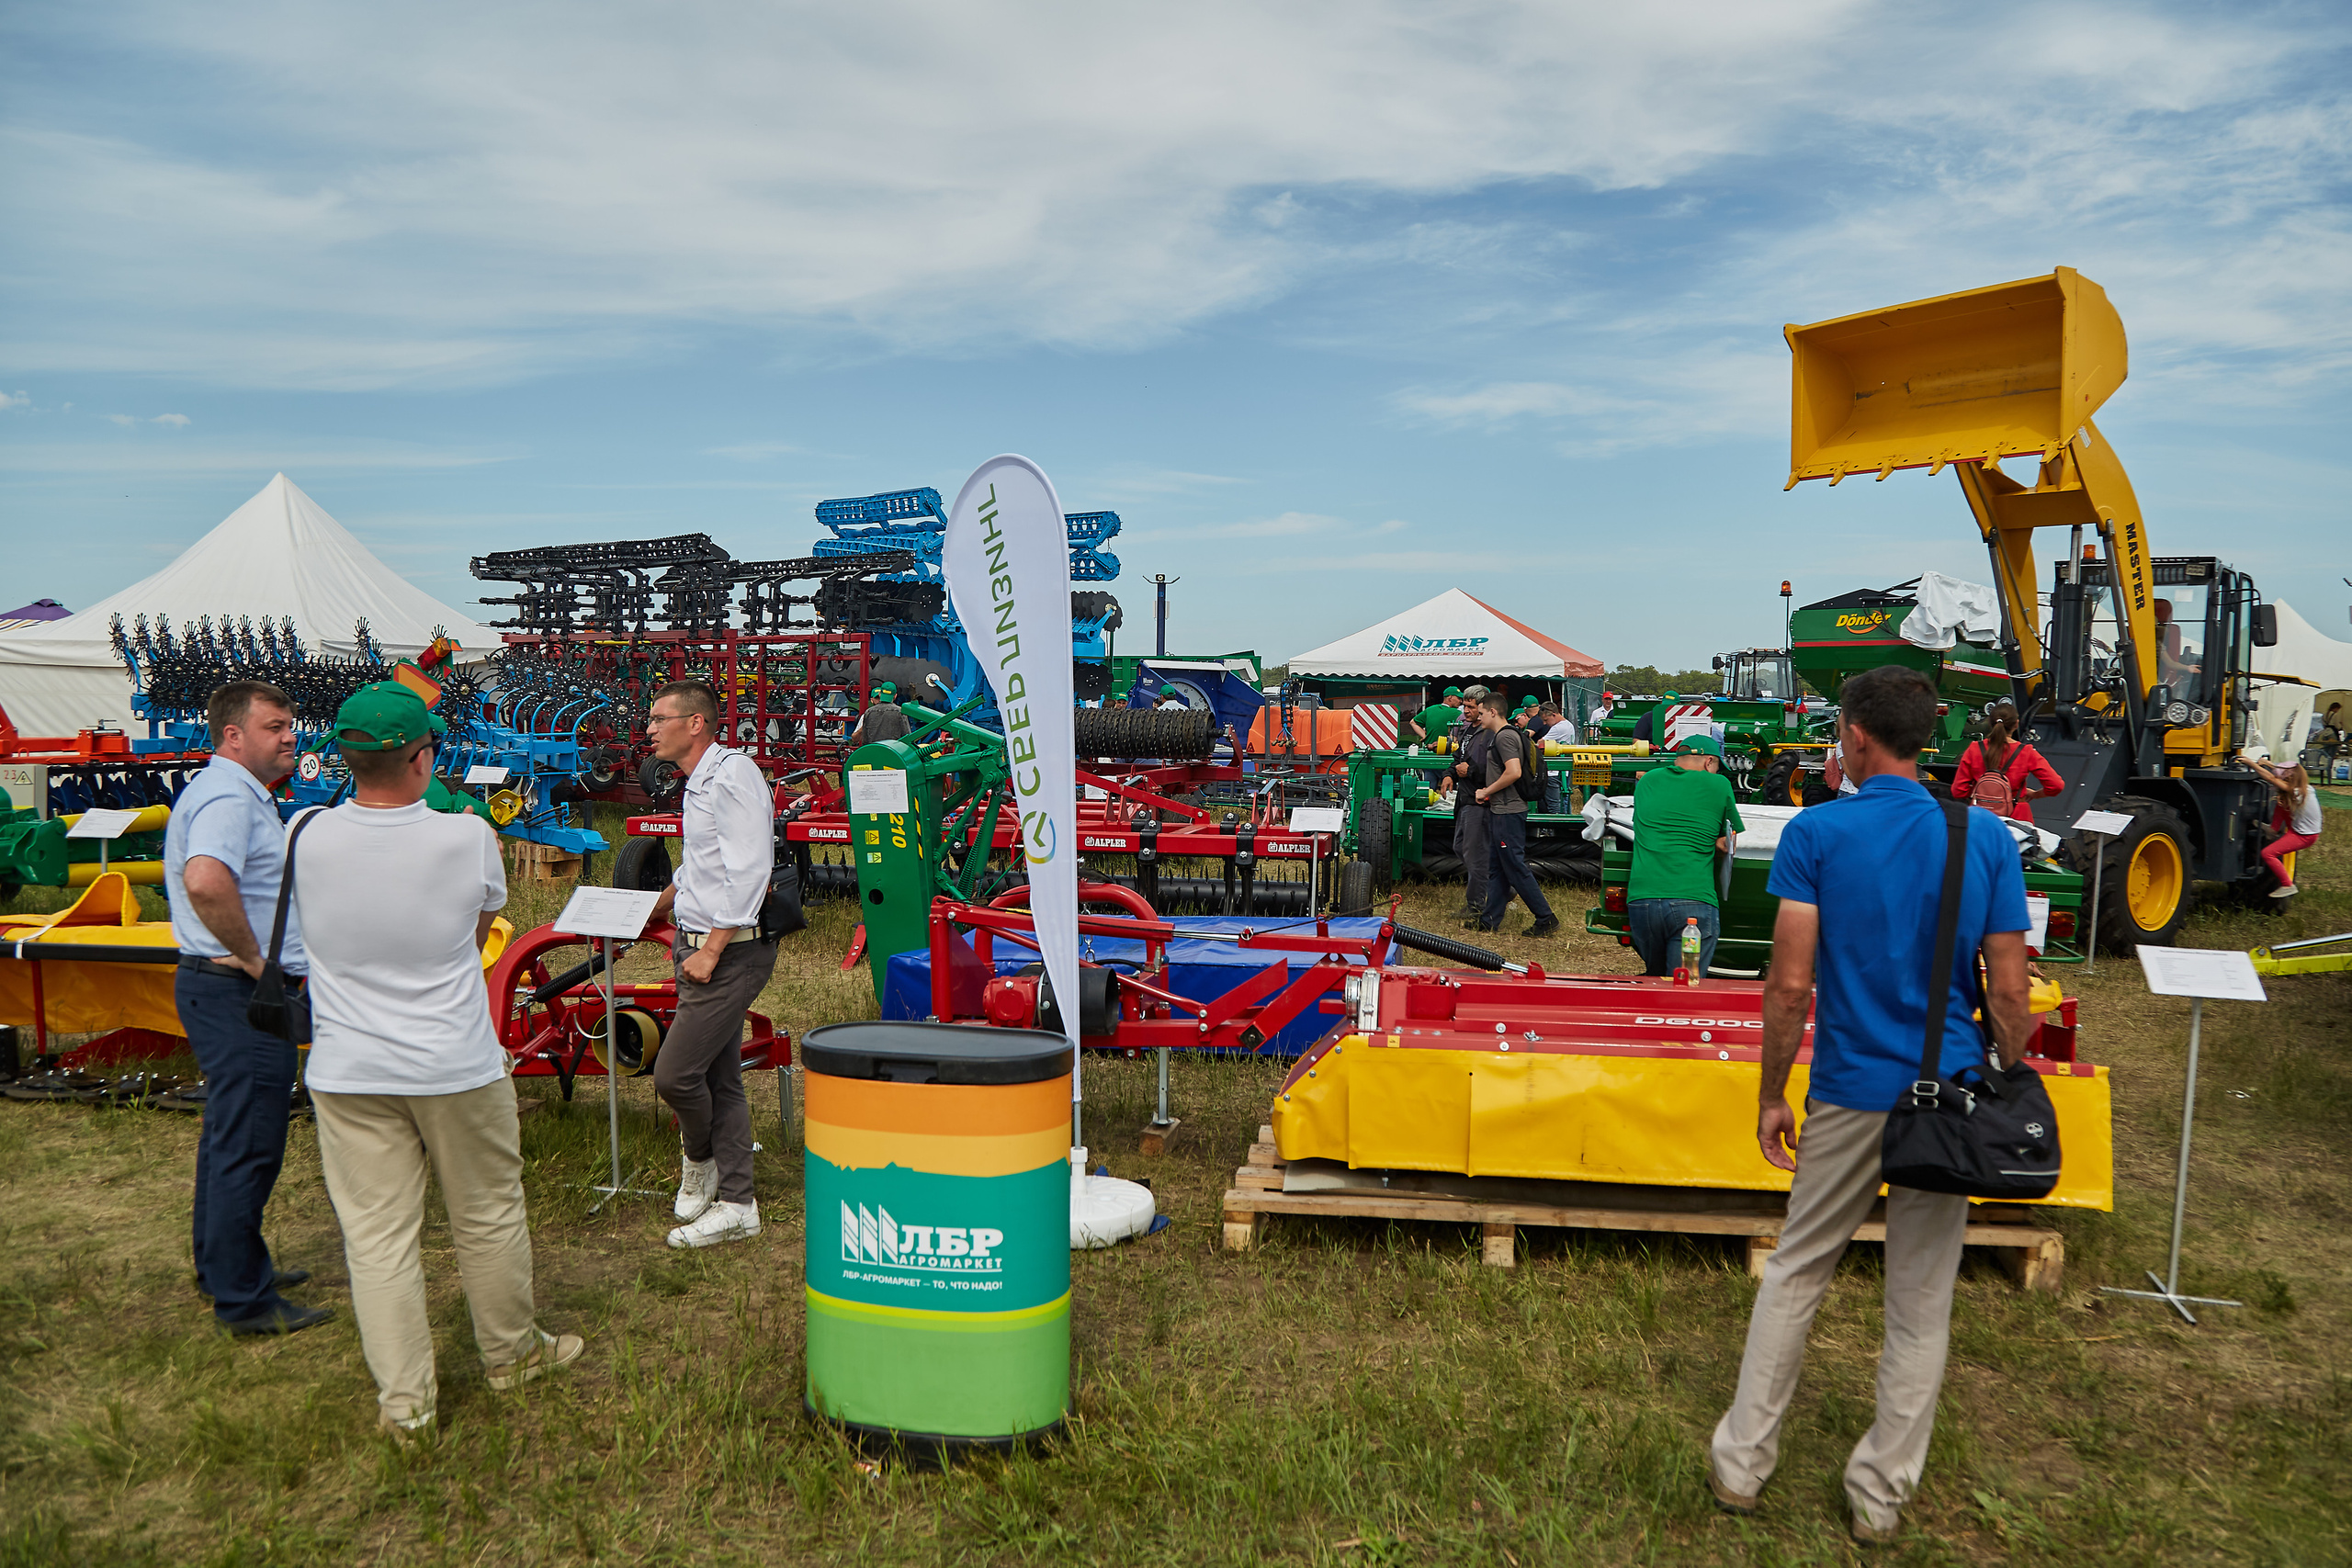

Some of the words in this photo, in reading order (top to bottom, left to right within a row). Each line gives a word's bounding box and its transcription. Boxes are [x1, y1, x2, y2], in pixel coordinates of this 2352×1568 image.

[2125, 522, 2145, 611] MASTER
[1422, 637, 1489, 649] ЛБР
[304, 759, 316, 774] 20
[649, 823, 677, 832] ALPLER
[818, 829, 848, 839] ALPLER
[888, 813, 907, 848] 210
[1094, 838, 1126, 848] ALPLER
[1277, 843, 1311, 853] ALPLER
[899, 1224, 1004, 1258] ЛБР
[899, 1255, 1003, 1269] АГРОМАРКЕТ
[842, 1269, 922, 1287] ЛБР-АГРОМАРКЕТ
[933, 1280, 948, 1291] ТО,
[950, 1280, 969, 1291] ЧТО
[971, 1280, 1003, 1292] НАДО!
